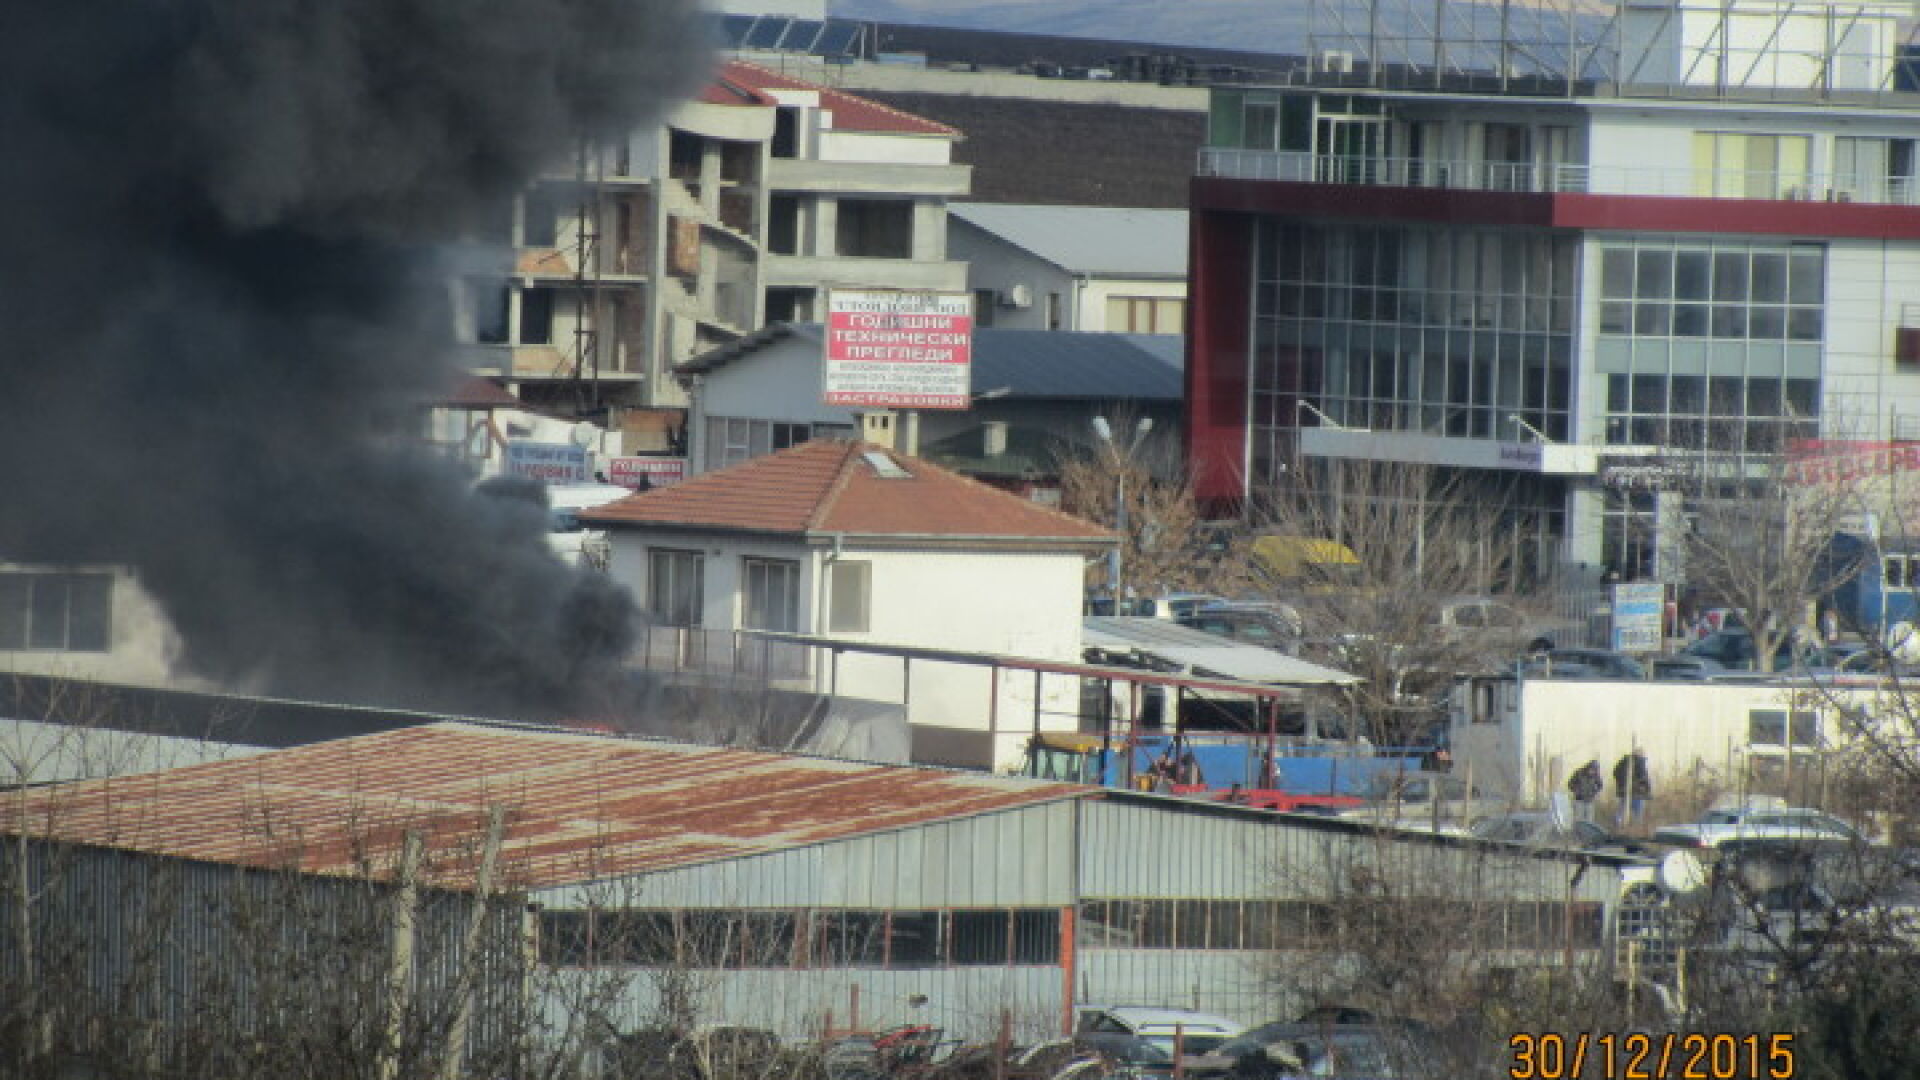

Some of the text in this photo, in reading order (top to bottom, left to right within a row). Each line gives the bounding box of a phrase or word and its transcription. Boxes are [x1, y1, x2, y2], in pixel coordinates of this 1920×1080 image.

[849, 313, 952, 330] ГОДИШНИ
[835, 329, 967, 346] ТЕХНИЧЕСКИ
[847, 345, 953, 362] ПРЕГЛЕДИ
